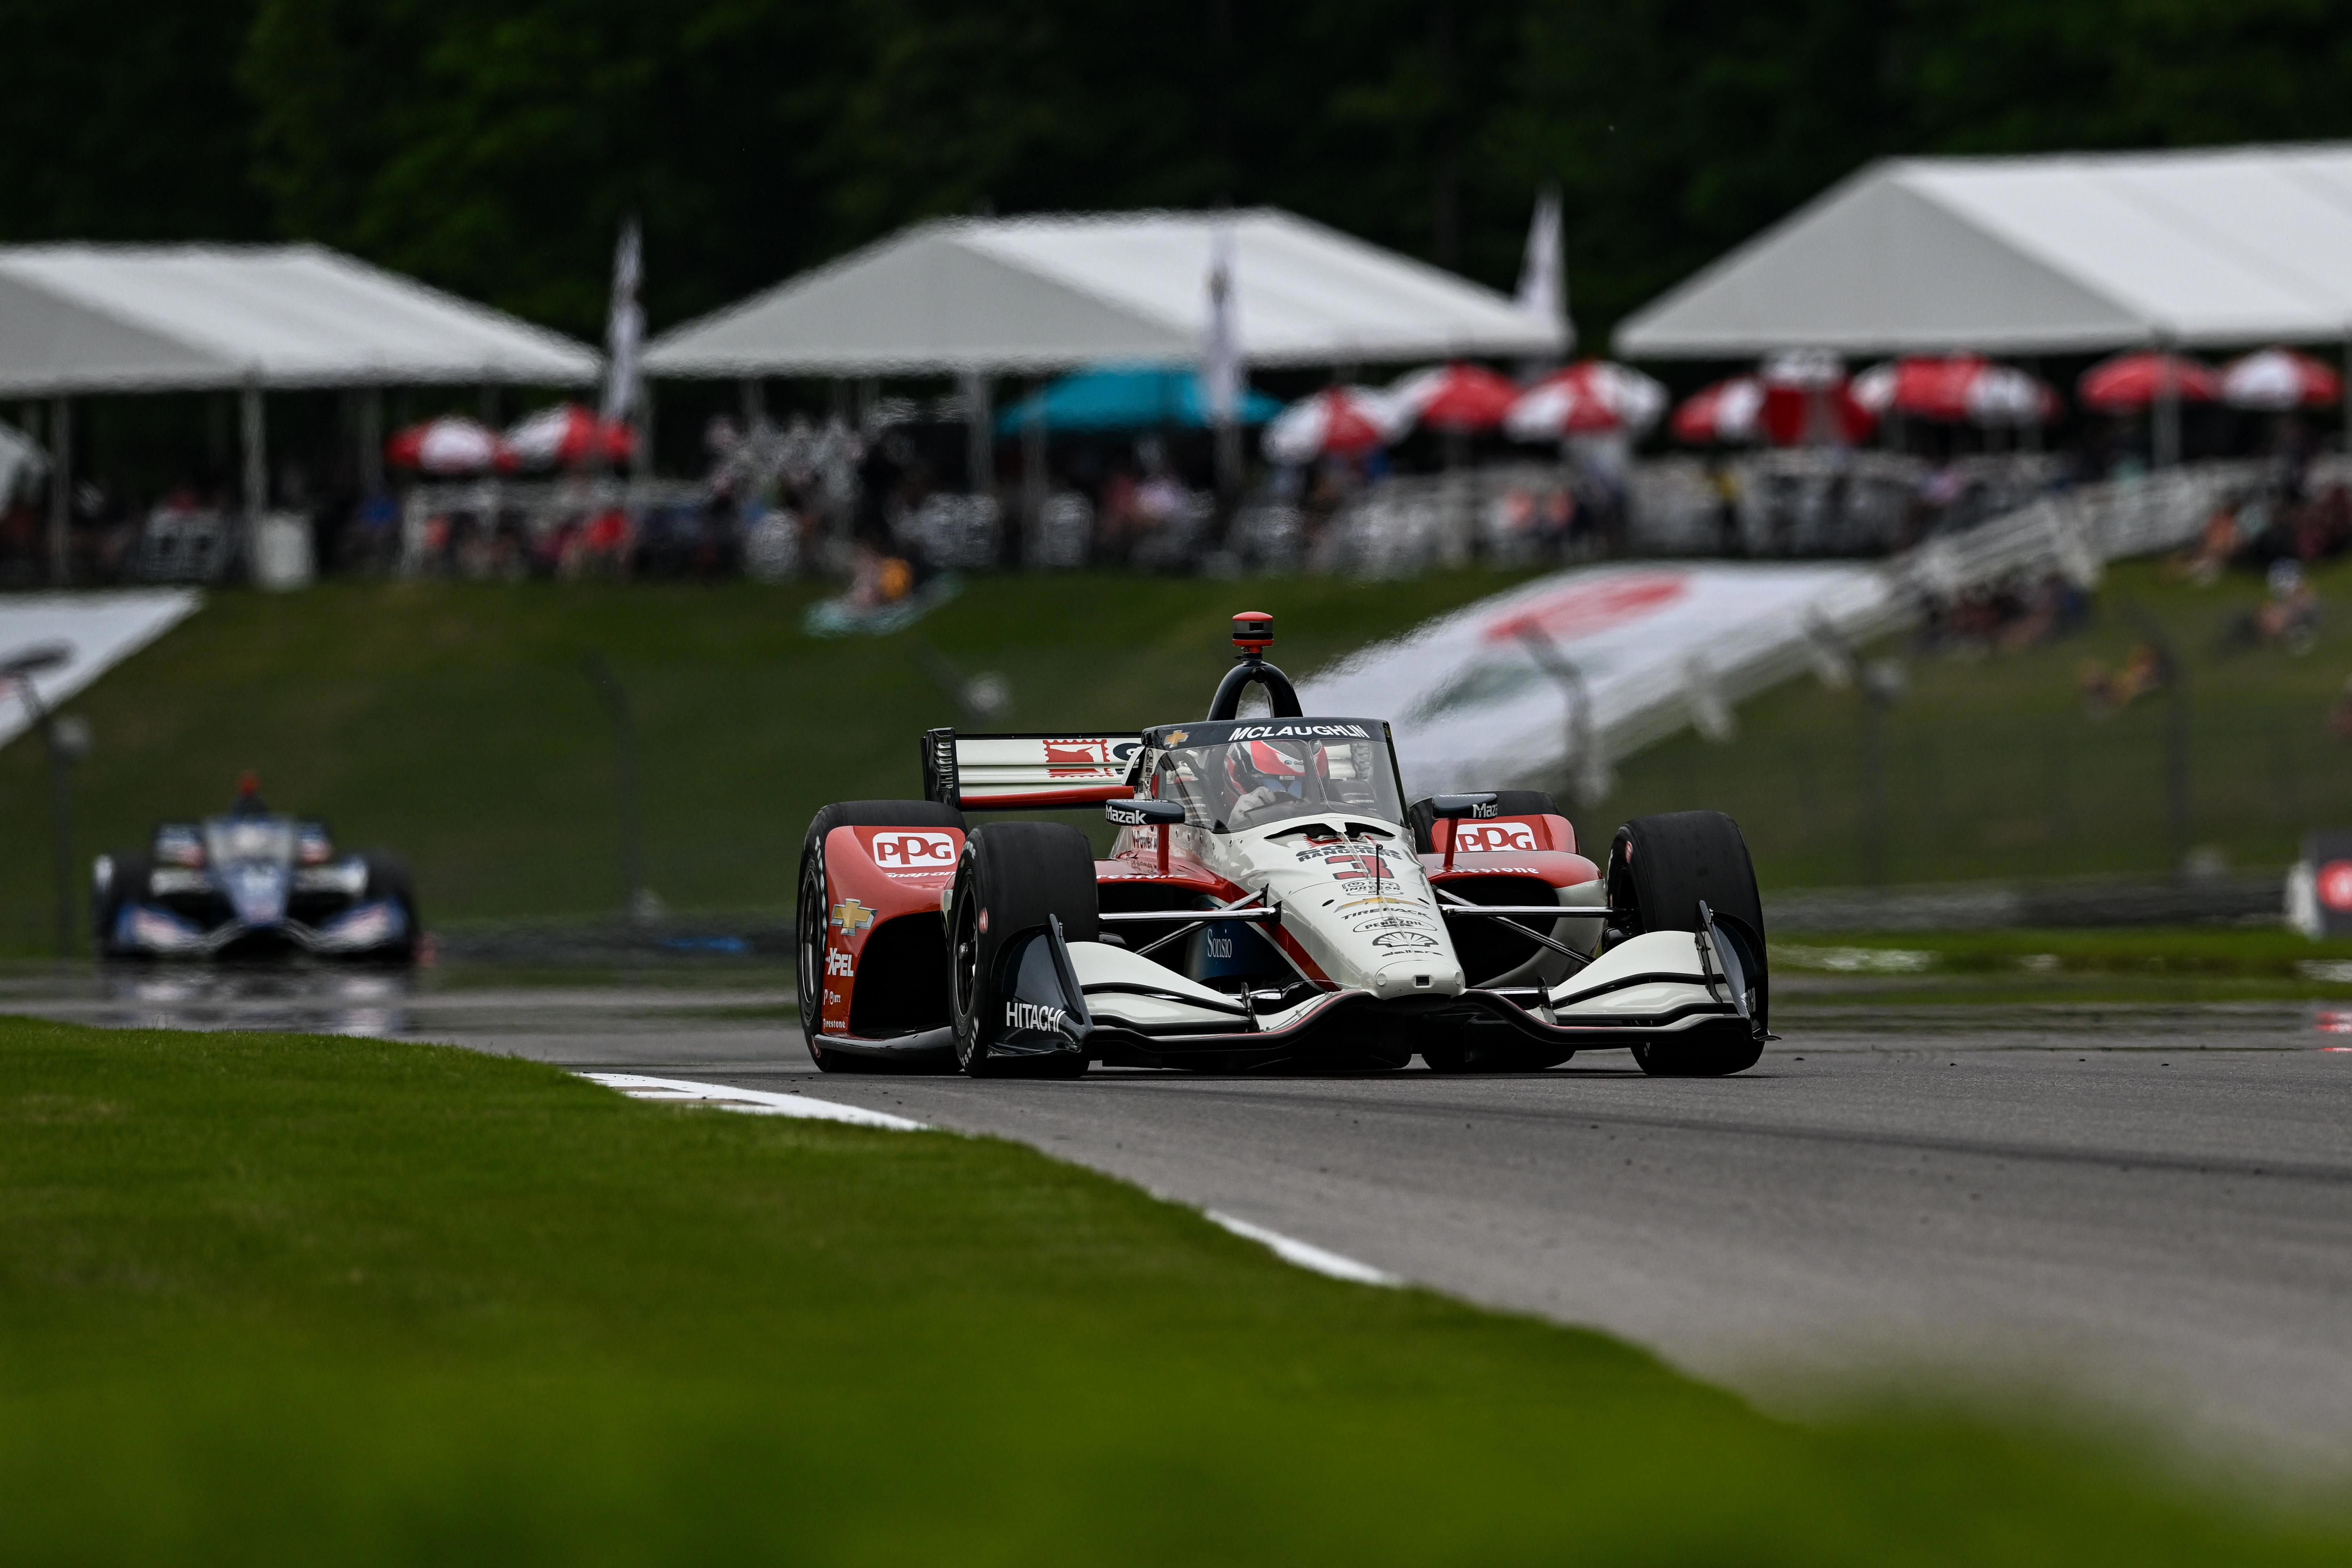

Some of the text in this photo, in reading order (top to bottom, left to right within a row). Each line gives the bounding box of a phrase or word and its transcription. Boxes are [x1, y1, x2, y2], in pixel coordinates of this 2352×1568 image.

[1228, 725, 1370, 741] MCLAUGHLIN
[1106, 804, 1147, 824] Mazak
[1457, 827, 1534, 851] PPG
[877, 837, 952, 865] PPG
[1298, 849, 1403, 862] RANCHERS
[1324, 855, 1395, 880] 3
[1341, 908, 1380, 920] TIRE
[1365, 920, 1425, 929] PENNZOIL
[1207, 929, 1232, 958] Sonsio
[827, 947, 854, 977] XPEL
[823, 1018, 846, 1029] Firestone
[1006, 1002, 1067, 1033] HITACHI
